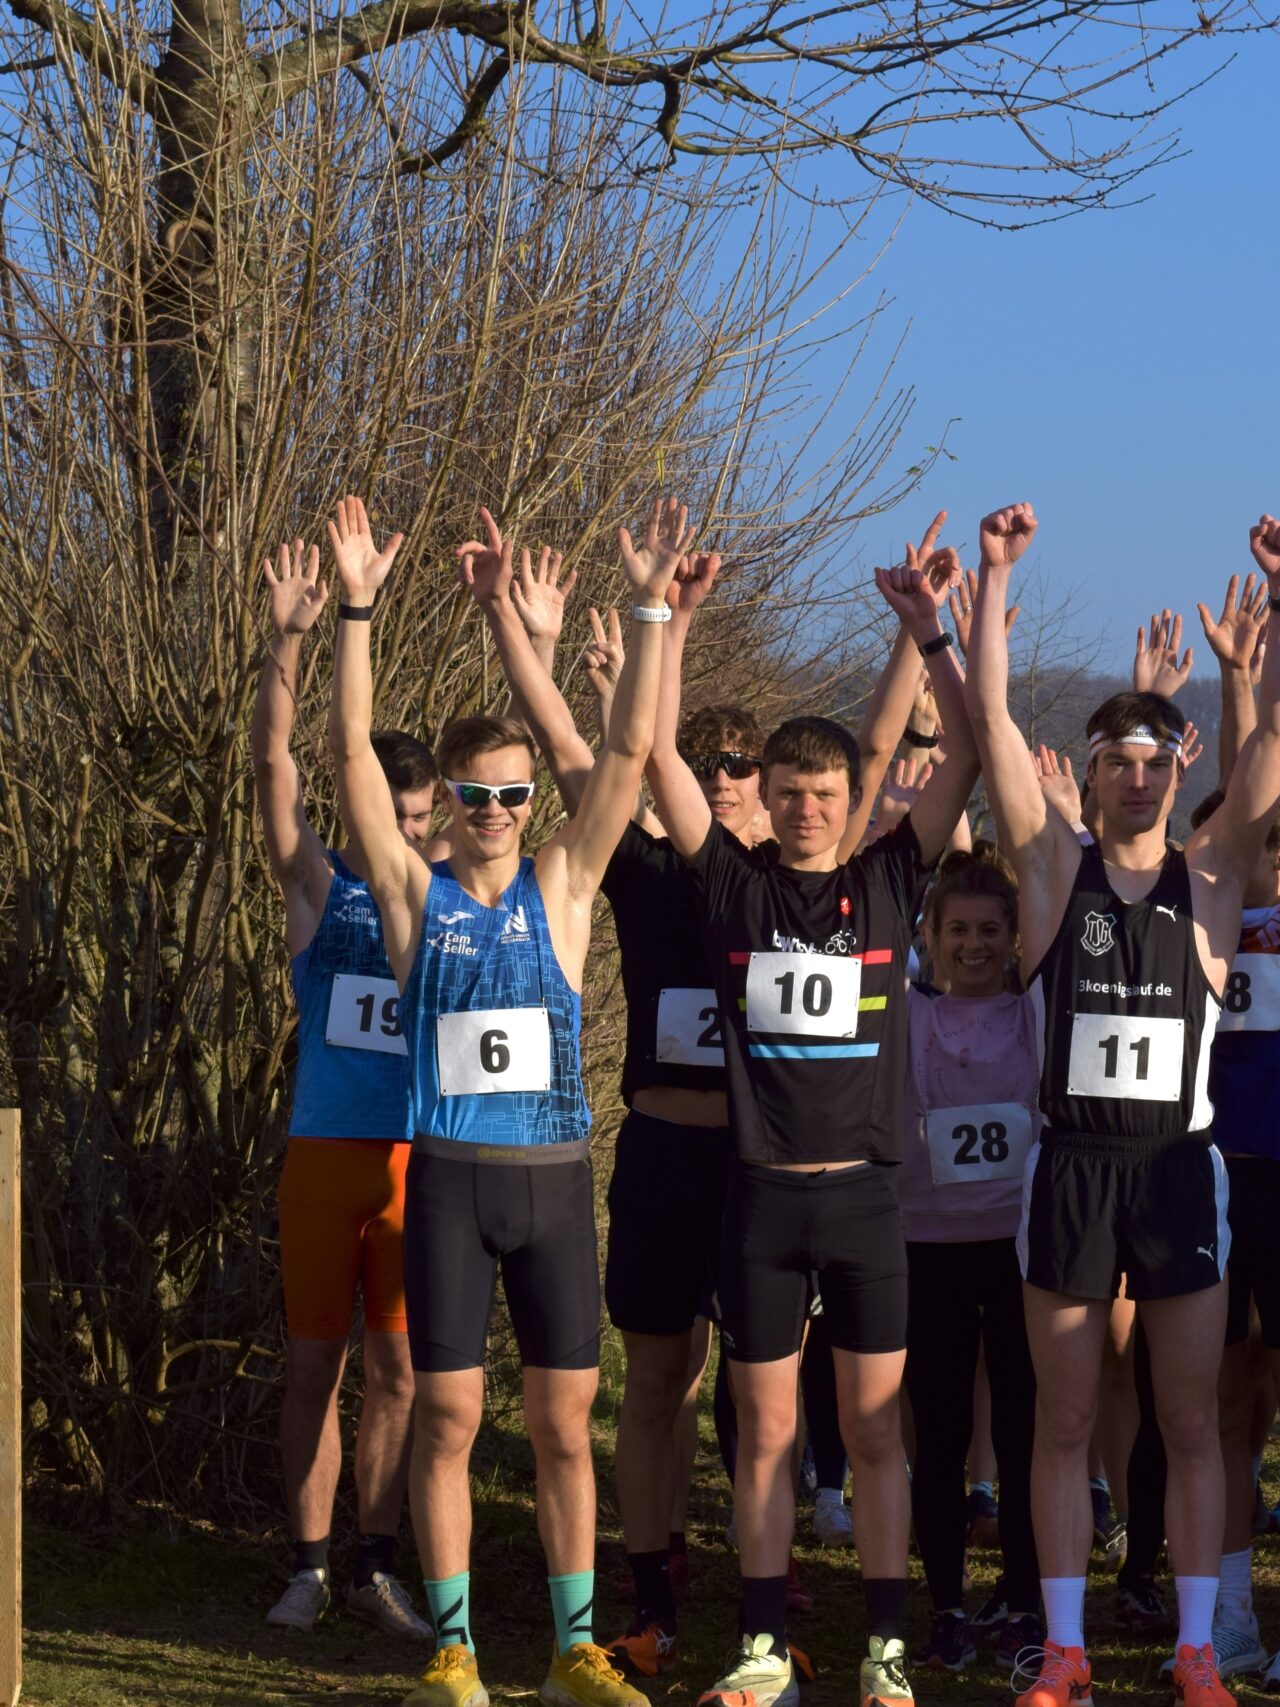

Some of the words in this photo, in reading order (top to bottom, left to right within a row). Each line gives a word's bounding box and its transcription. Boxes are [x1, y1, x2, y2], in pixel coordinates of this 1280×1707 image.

[347, 904, 371, 914] Cam
[443, 942, 479, 956] Seller
[445, 931, 471, 945] Cam
[1089, 918, 1109, 947] TSG
[774, 971, 833, 1018] 10
[1078, 979, 1172, 999] 3koenigslauf.de
[1221, 971, 1252, 1013] 8
[355, 993, 403, 1037] 19
[479, 1029, 511, 1074] 6
[1098, 1034, 1151, 1081] 11
[951, 1121, 1009, 1165] 28
